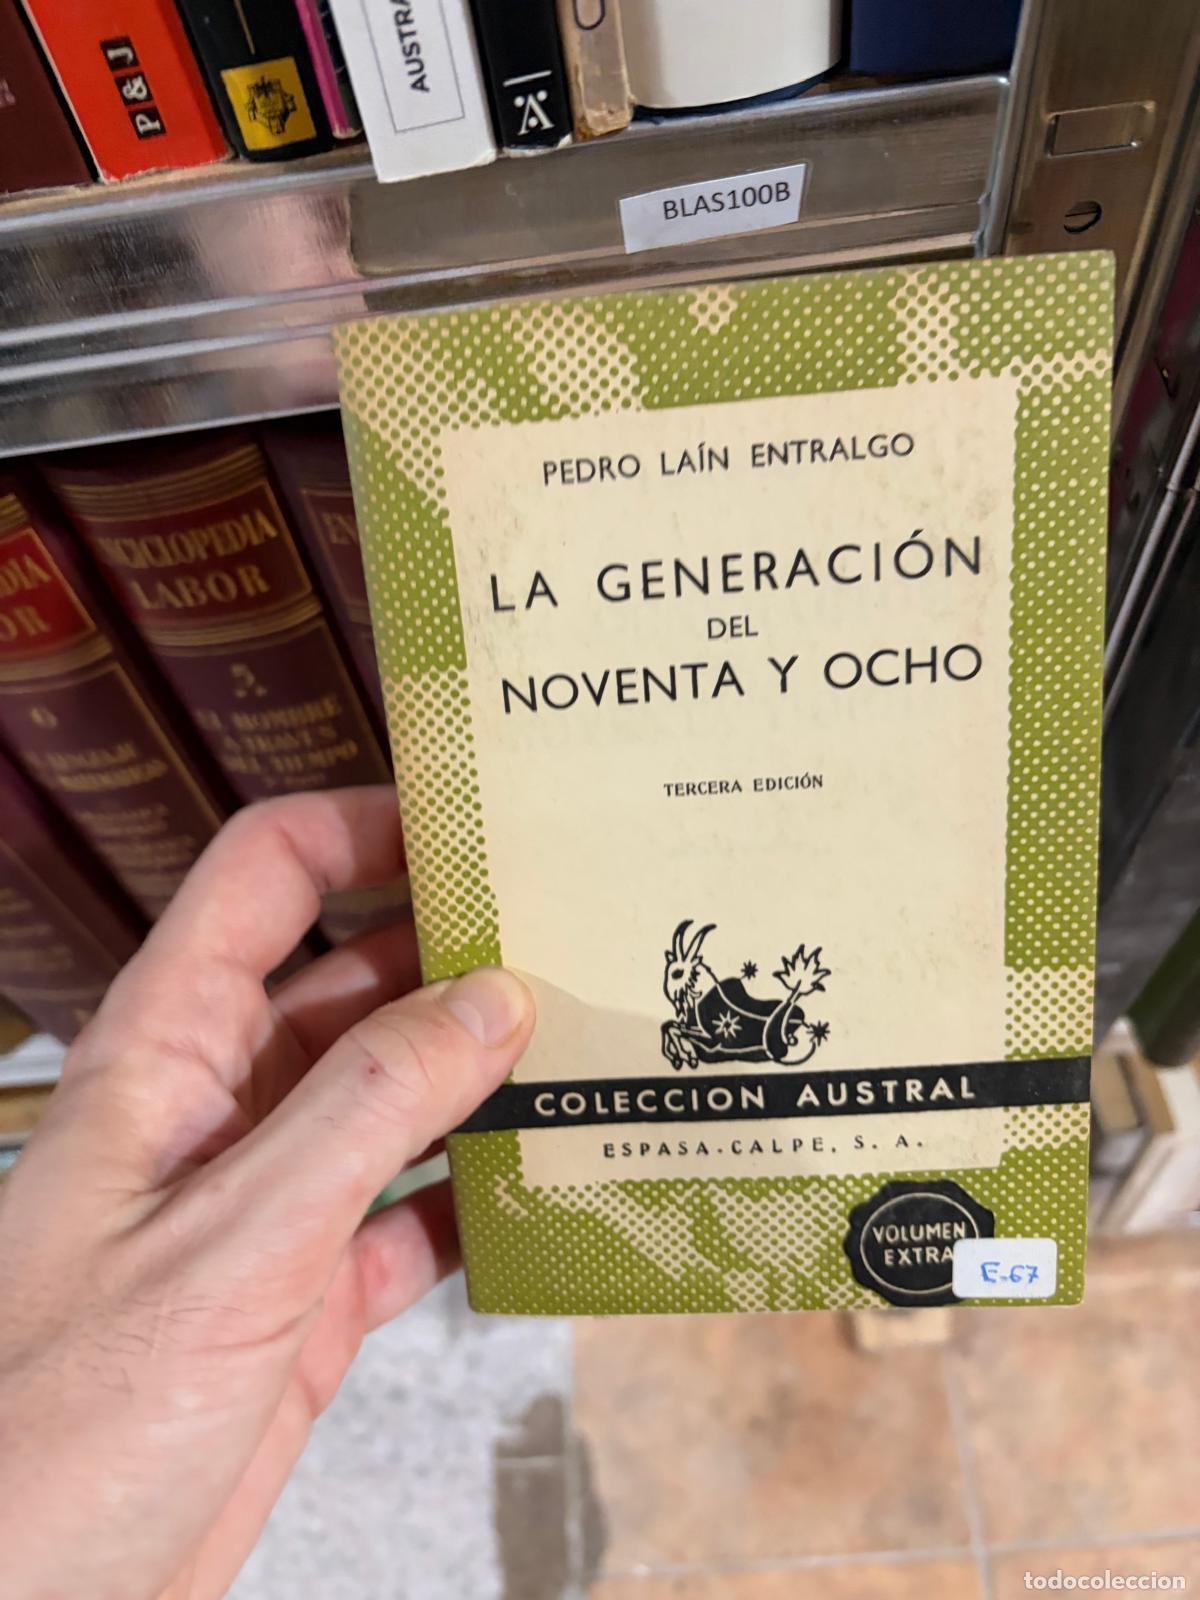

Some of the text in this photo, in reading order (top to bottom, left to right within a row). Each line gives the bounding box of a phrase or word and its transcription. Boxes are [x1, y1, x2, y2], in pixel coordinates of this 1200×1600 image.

[662, 181, 791, 220] BLAS100B
[543, 433, 915, 487] PEDRO LAÍN ENTRALGO
[129, 563, 271, 609] LABOR
[490, 529, 981, 613] LA GENERACIÓN
[708, 615, 758, 640] DEL
[501, 644, 983, 714] NOVENTA Y OCHO
[664, 772, 823, 797] TERCERA EDICIÓN
[535, 1074, 976, 1117] COLECCION AUSTRAL
[854, 1135, 878, 1149] S.
[896, 1134, 923, 1148] A.
[872, 1221, 967, 1244] VOLUMEN
[884, 1245, 954, 1266] EXTRA
